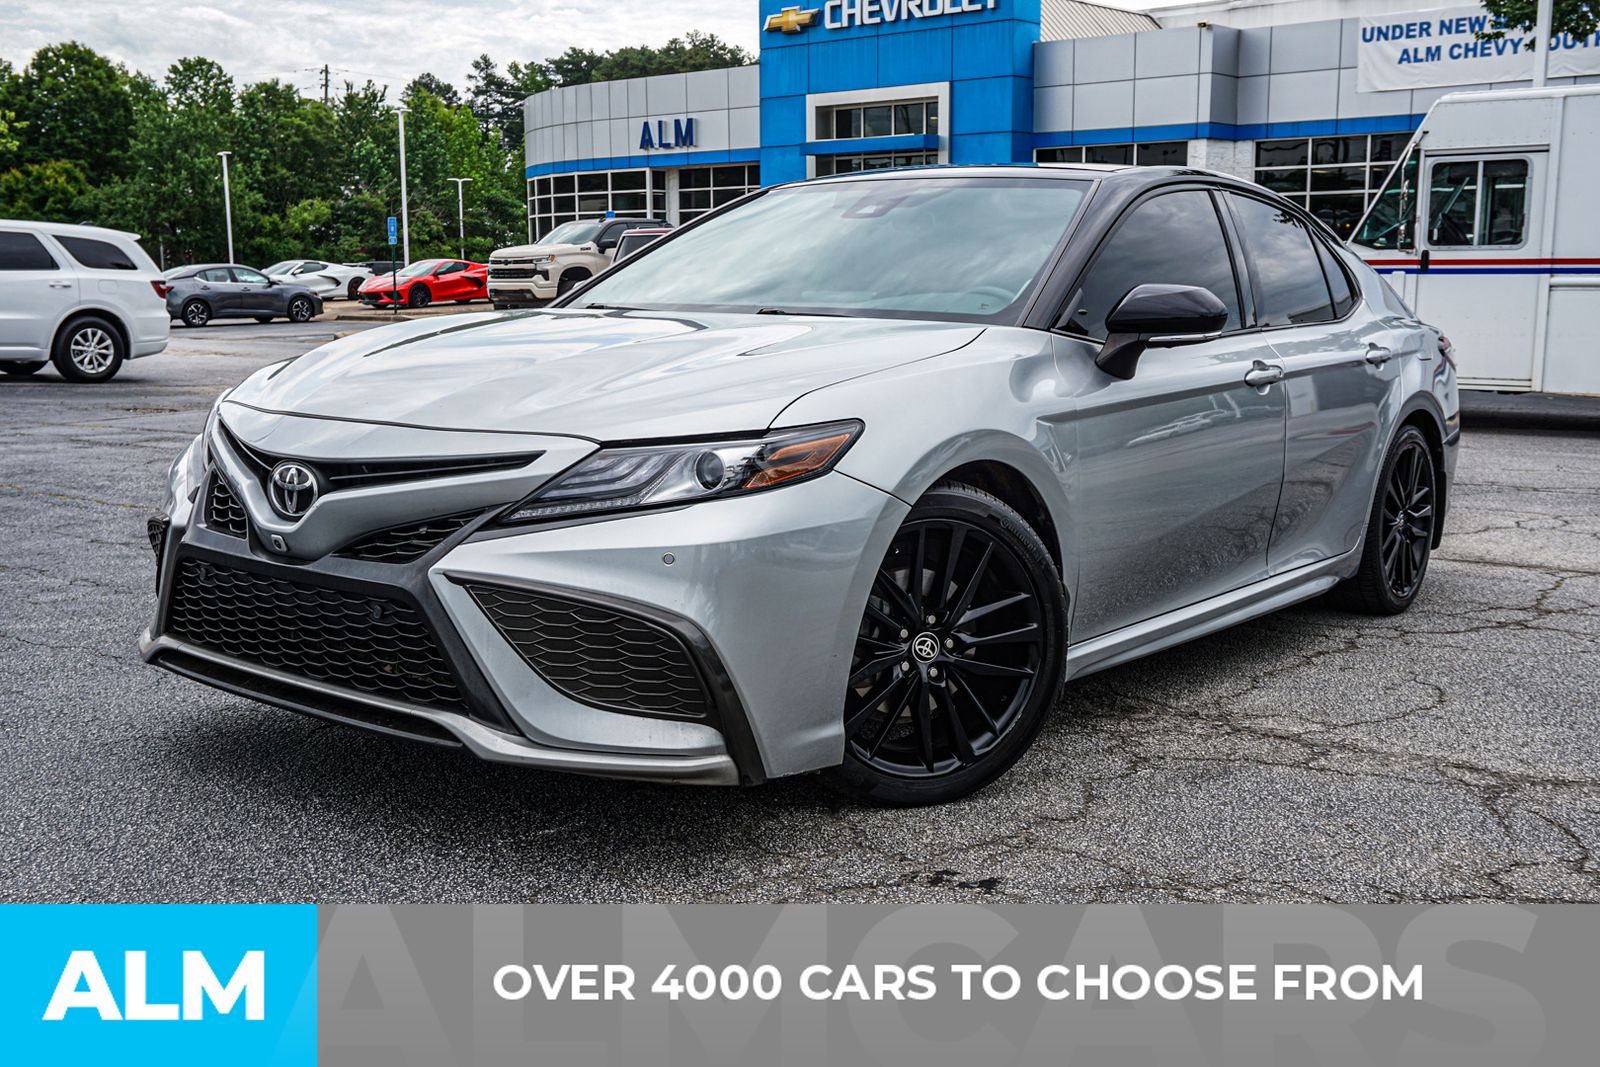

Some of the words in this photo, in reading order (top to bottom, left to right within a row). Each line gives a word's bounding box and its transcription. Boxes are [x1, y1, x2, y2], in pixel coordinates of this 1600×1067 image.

[1362, 21, 1432, 43] UNDER
[1439, 15, 1487, 36] NEW
[1398, 45, 1442, 64] ALM
[1449, 38, 1523, 60] CHEVY
[639, 118, 694, 149] ALM
